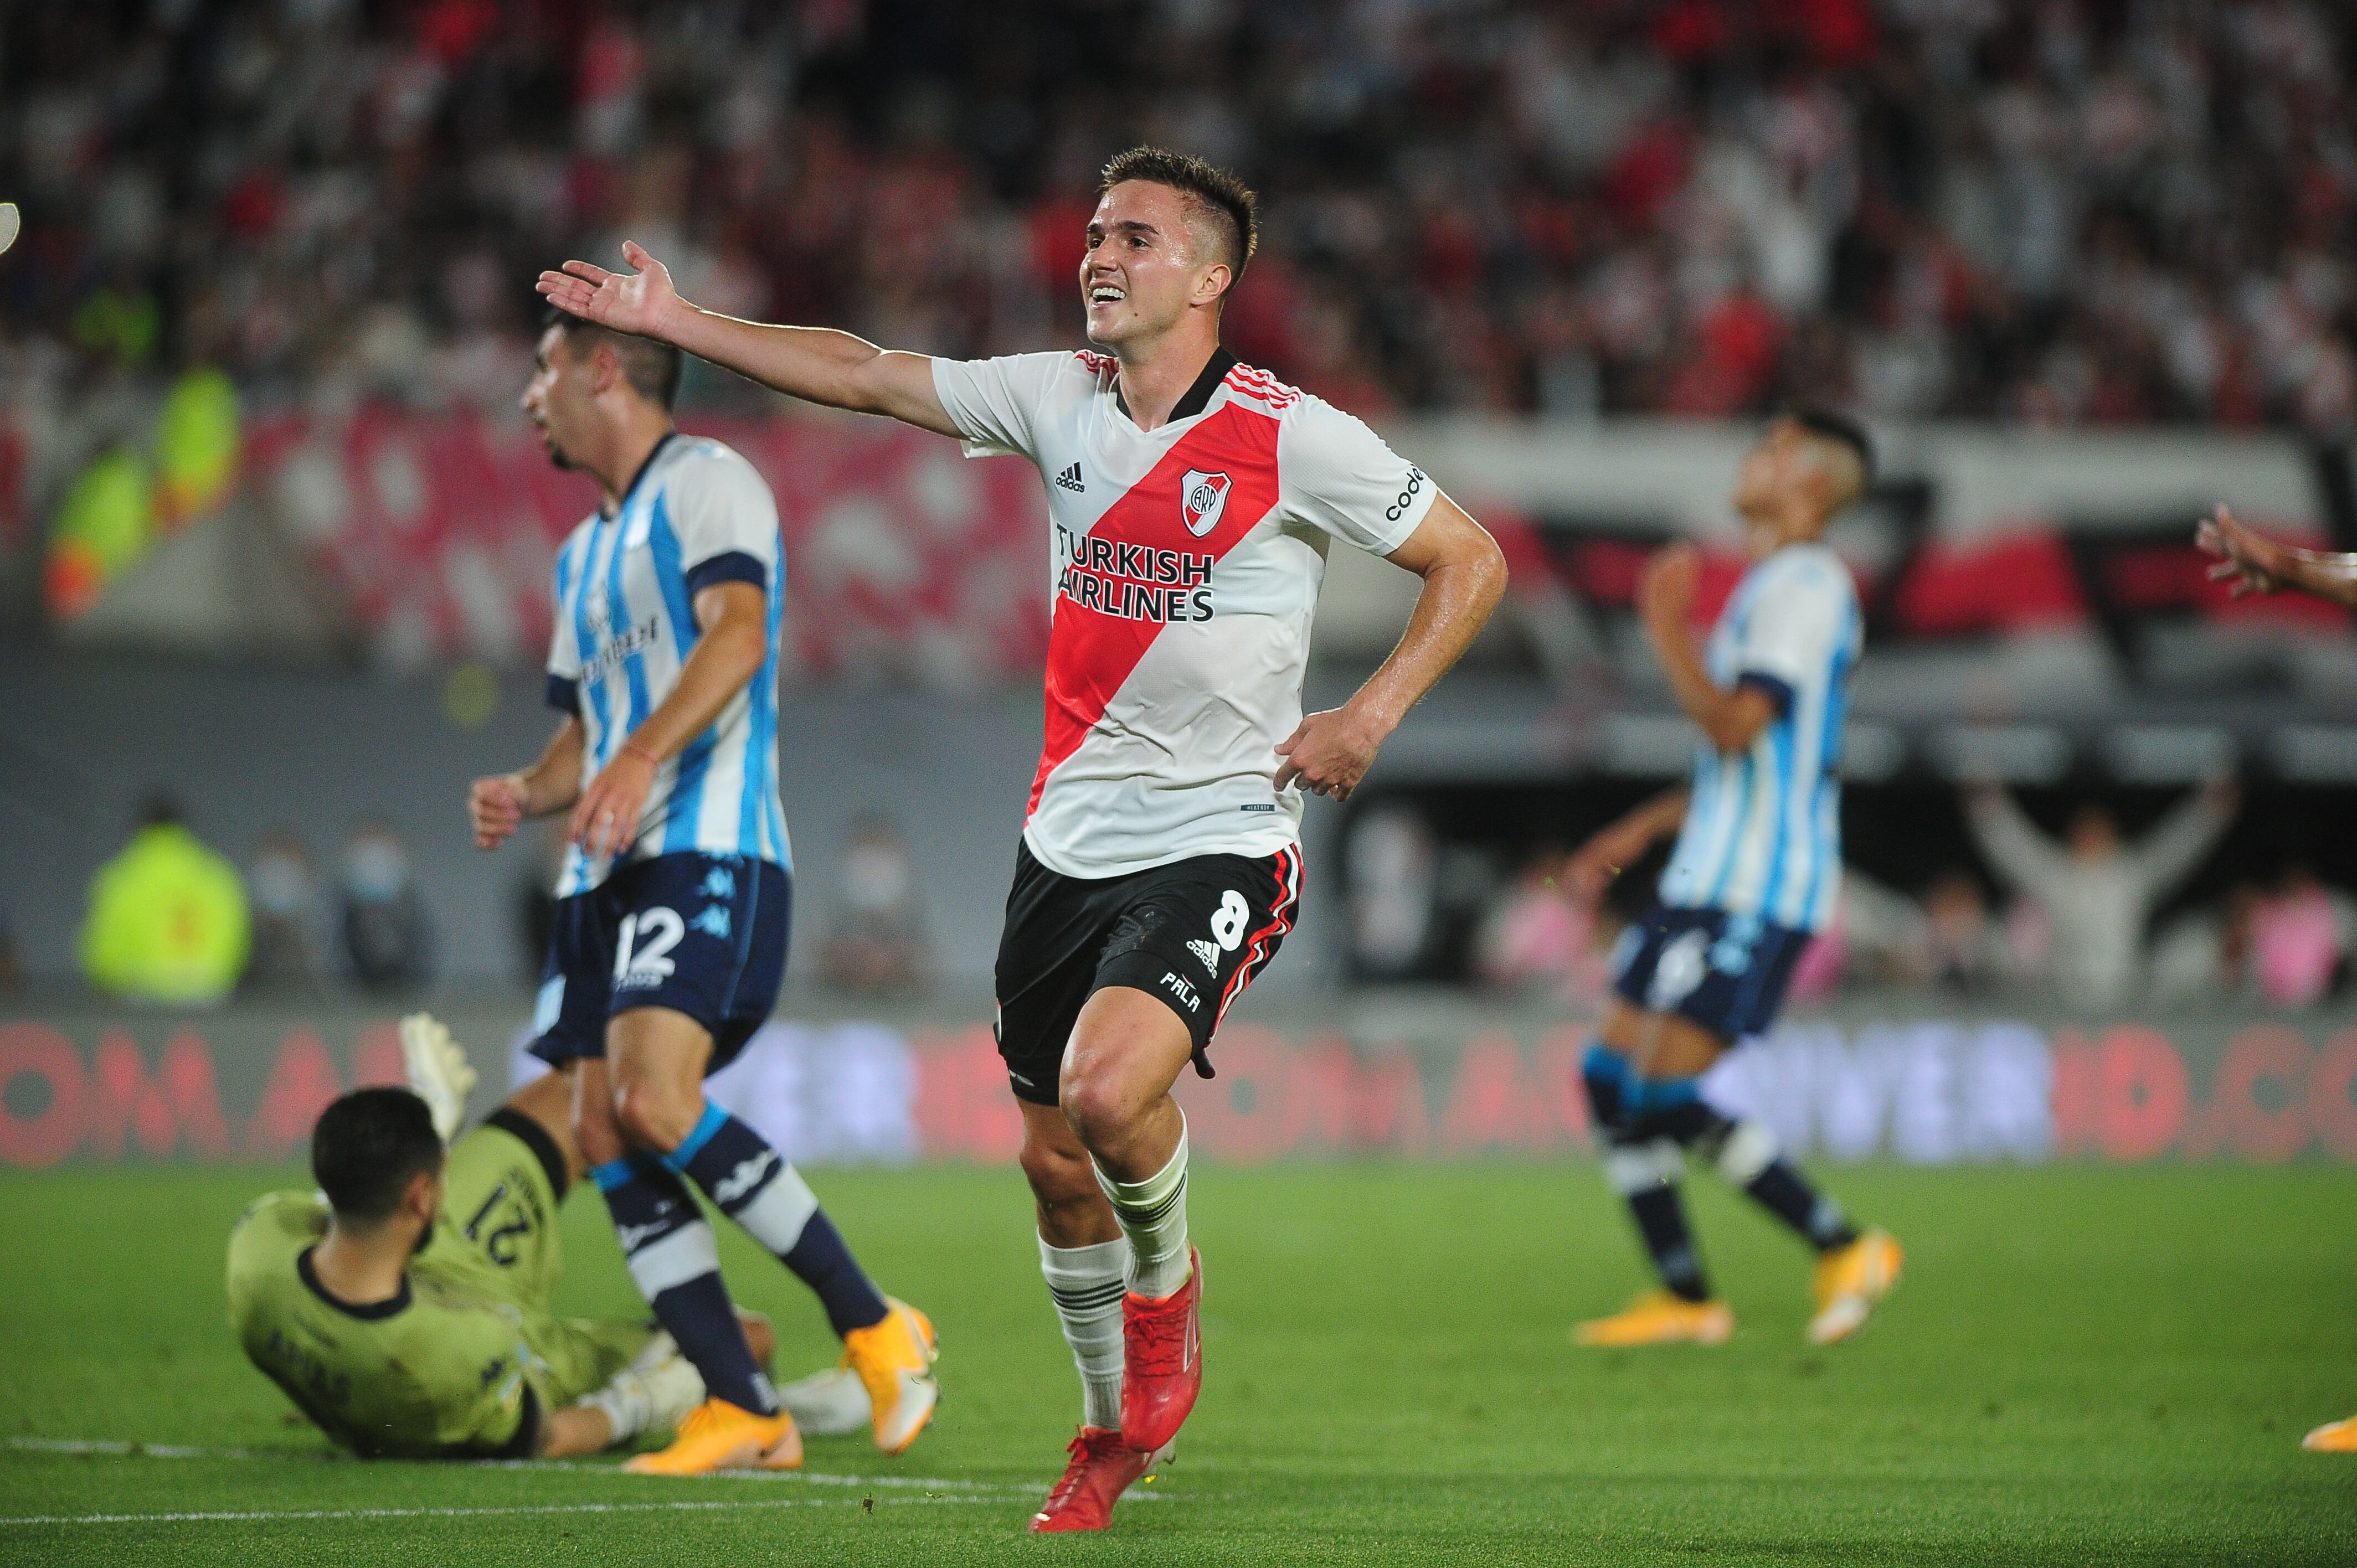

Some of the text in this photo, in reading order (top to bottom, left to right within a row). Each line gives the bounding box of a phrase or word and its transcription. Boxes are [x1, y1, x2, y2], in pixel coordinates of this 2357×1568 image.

[1056, 476, 1085, 493] adidas
[1057, 523, 1214, 586] TURKISH
[1058, 565, 1214, 623] AIRLINES
[613, 906, 685, 982] 12
[1211, 890, 1250, 951] 8
[1186, 941, 1217, 979] adidas
[1160, 972, 1201, 1013] PALA
